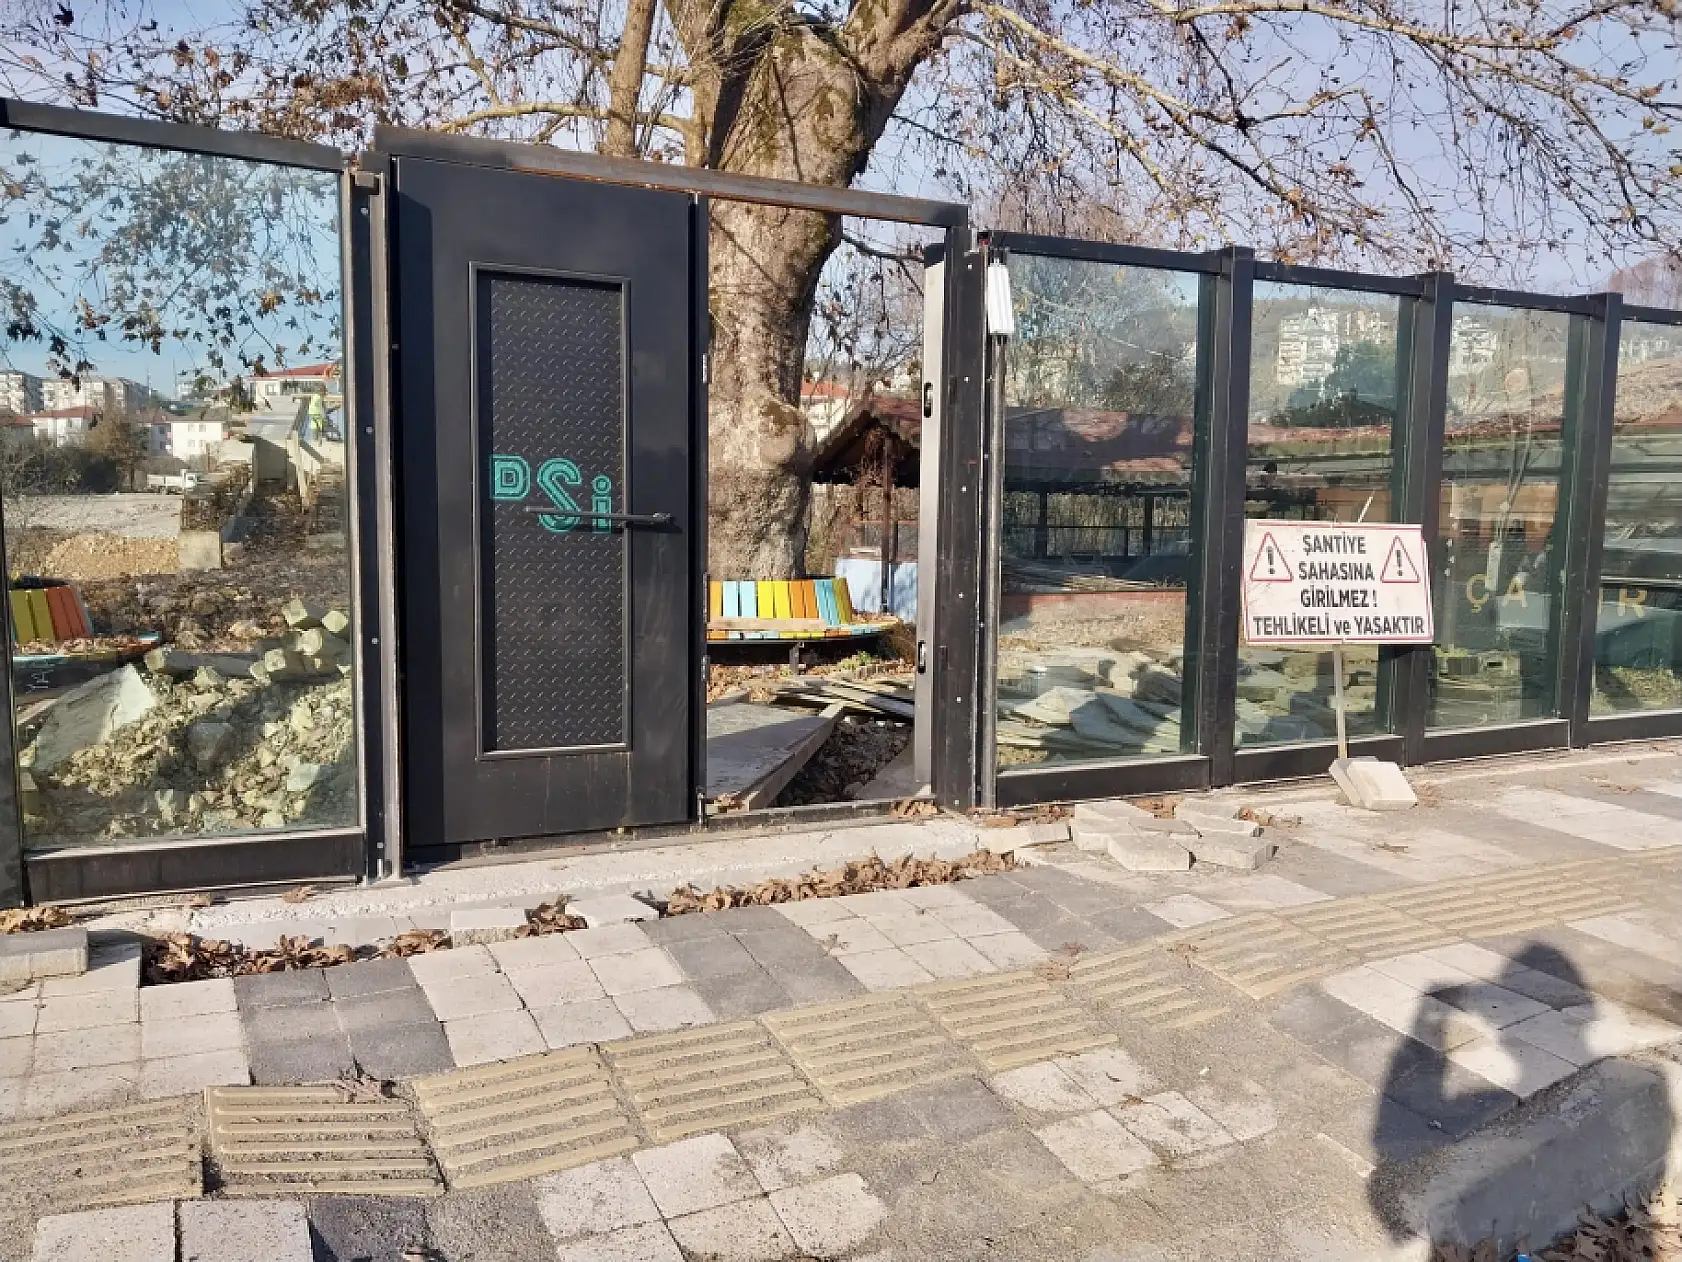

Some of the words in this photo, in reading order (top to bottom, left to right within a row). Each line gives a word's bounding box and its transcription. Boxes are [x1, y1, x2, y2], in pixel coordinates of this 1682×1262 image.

[1302, 532, 1367, 556] ŞANTİYE
[1298, 562, 1375, 581] SAHASINA
[1253, 612, 1331, 636] TEHLİKELİ
[1333, 619, 1351, 635] ve
[1353, 615, 1425, 635] YASAKTIR
